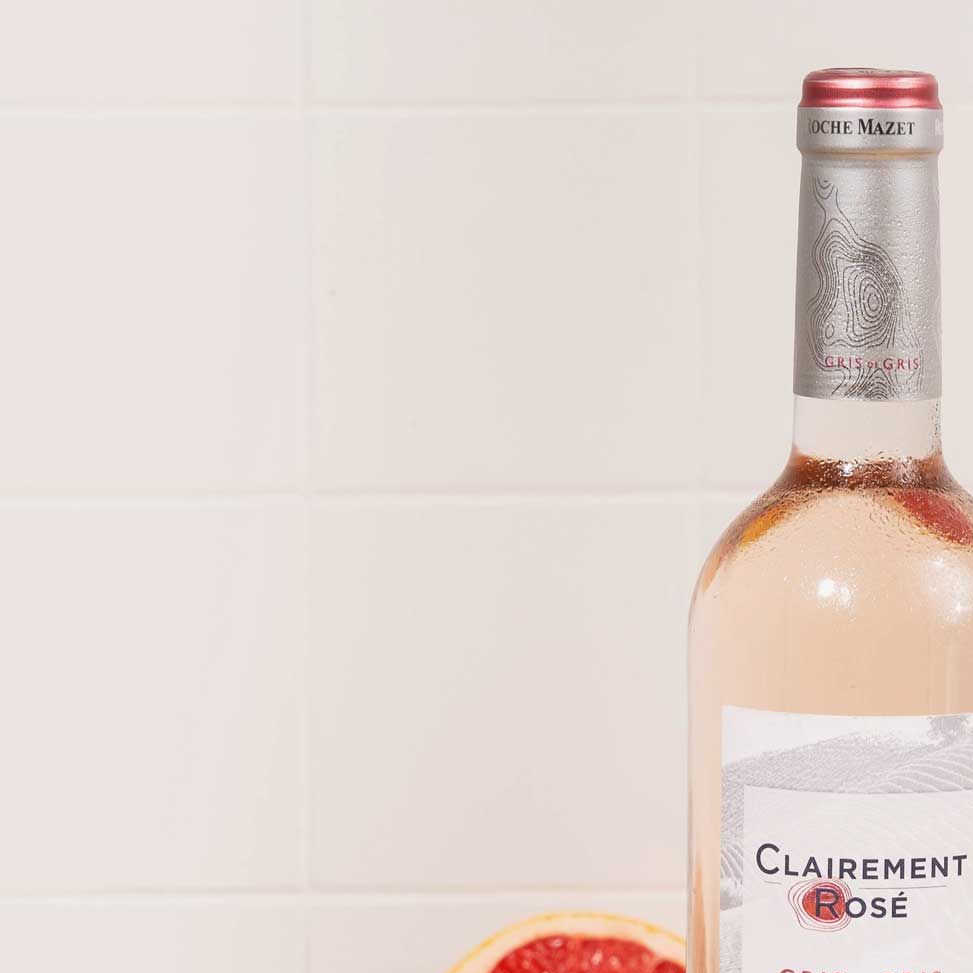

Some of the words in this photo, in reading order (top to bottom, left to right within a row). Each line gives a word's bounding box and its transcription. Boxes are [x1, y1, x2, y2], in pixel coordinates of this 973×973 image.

[857, 118, 915, 135] MAZET
[824, 355, 862, 369] GRIS
[883, 358, 919, 370] GRIS
[756, 843, 967, 880] CLAIREMENT
[815, 887, 908, 919] ROSÉ
